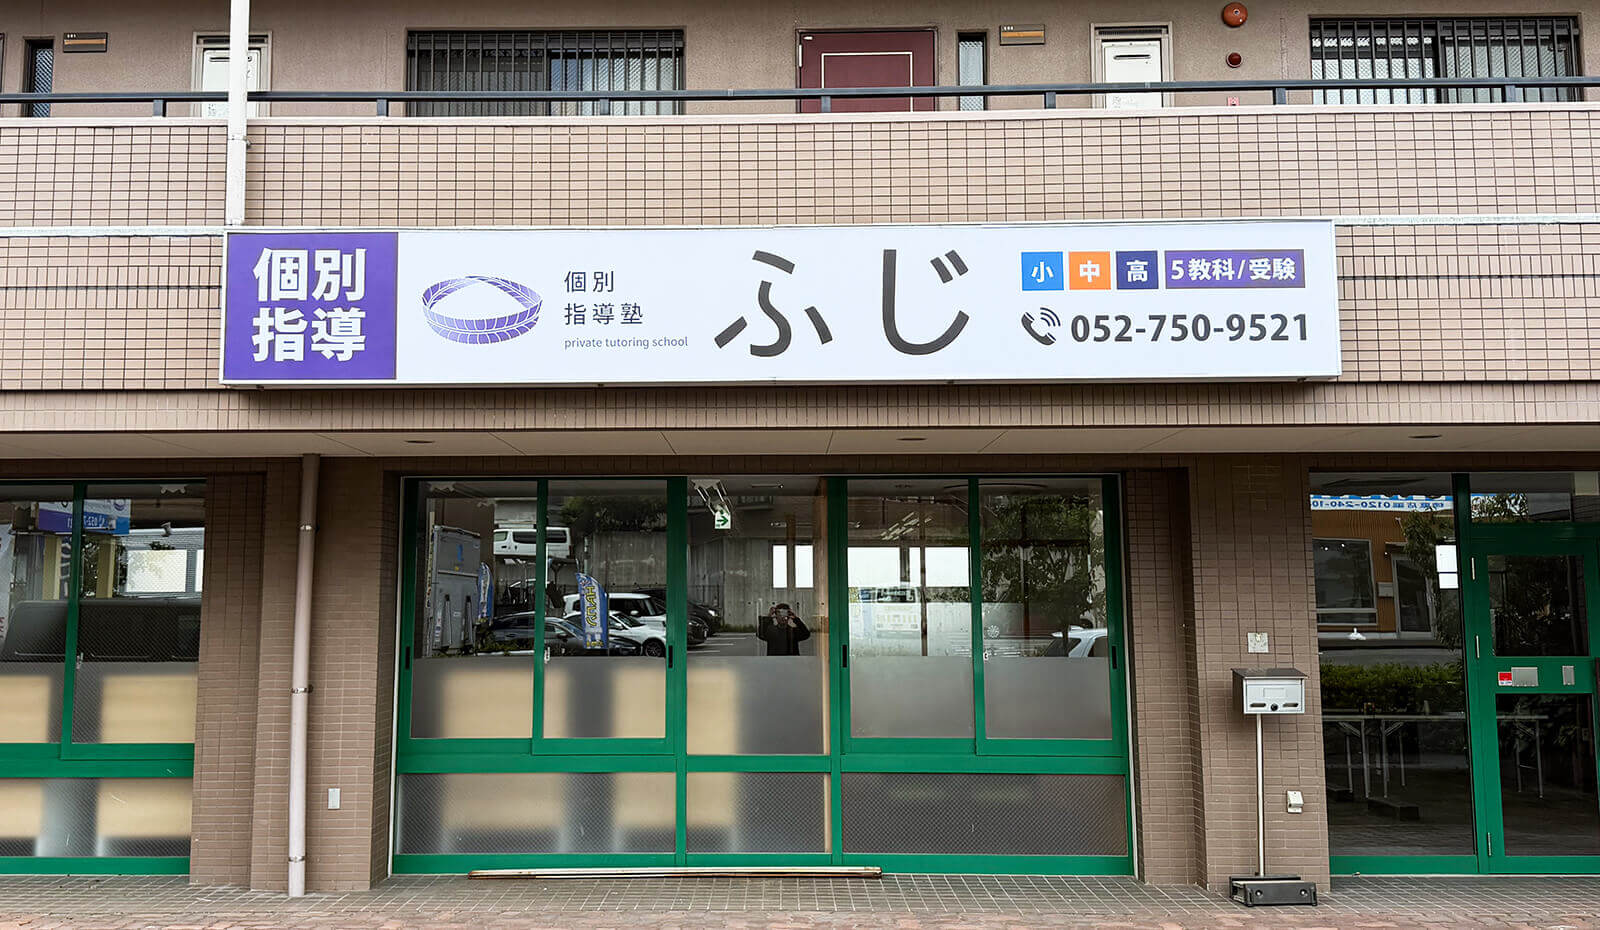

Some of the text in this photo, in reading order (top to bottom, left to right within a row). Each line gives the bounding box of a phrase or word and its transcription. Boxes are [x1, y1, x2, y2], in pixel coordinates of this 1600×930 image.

[252, 247, 366, 302] 個別
[564, 270, 615, 293] 個別
[1031, 257, 1297, 283] 小 中 高 5教科/受験
[564, 302, 643, 326] 指導塾
[714, 249, 970, 358] ふじ
[252, 307, 366, 362] 指導
[1070, 313, 1308, 343] 052-750-9521
[564, 336, 688, 351] private tutoring school
